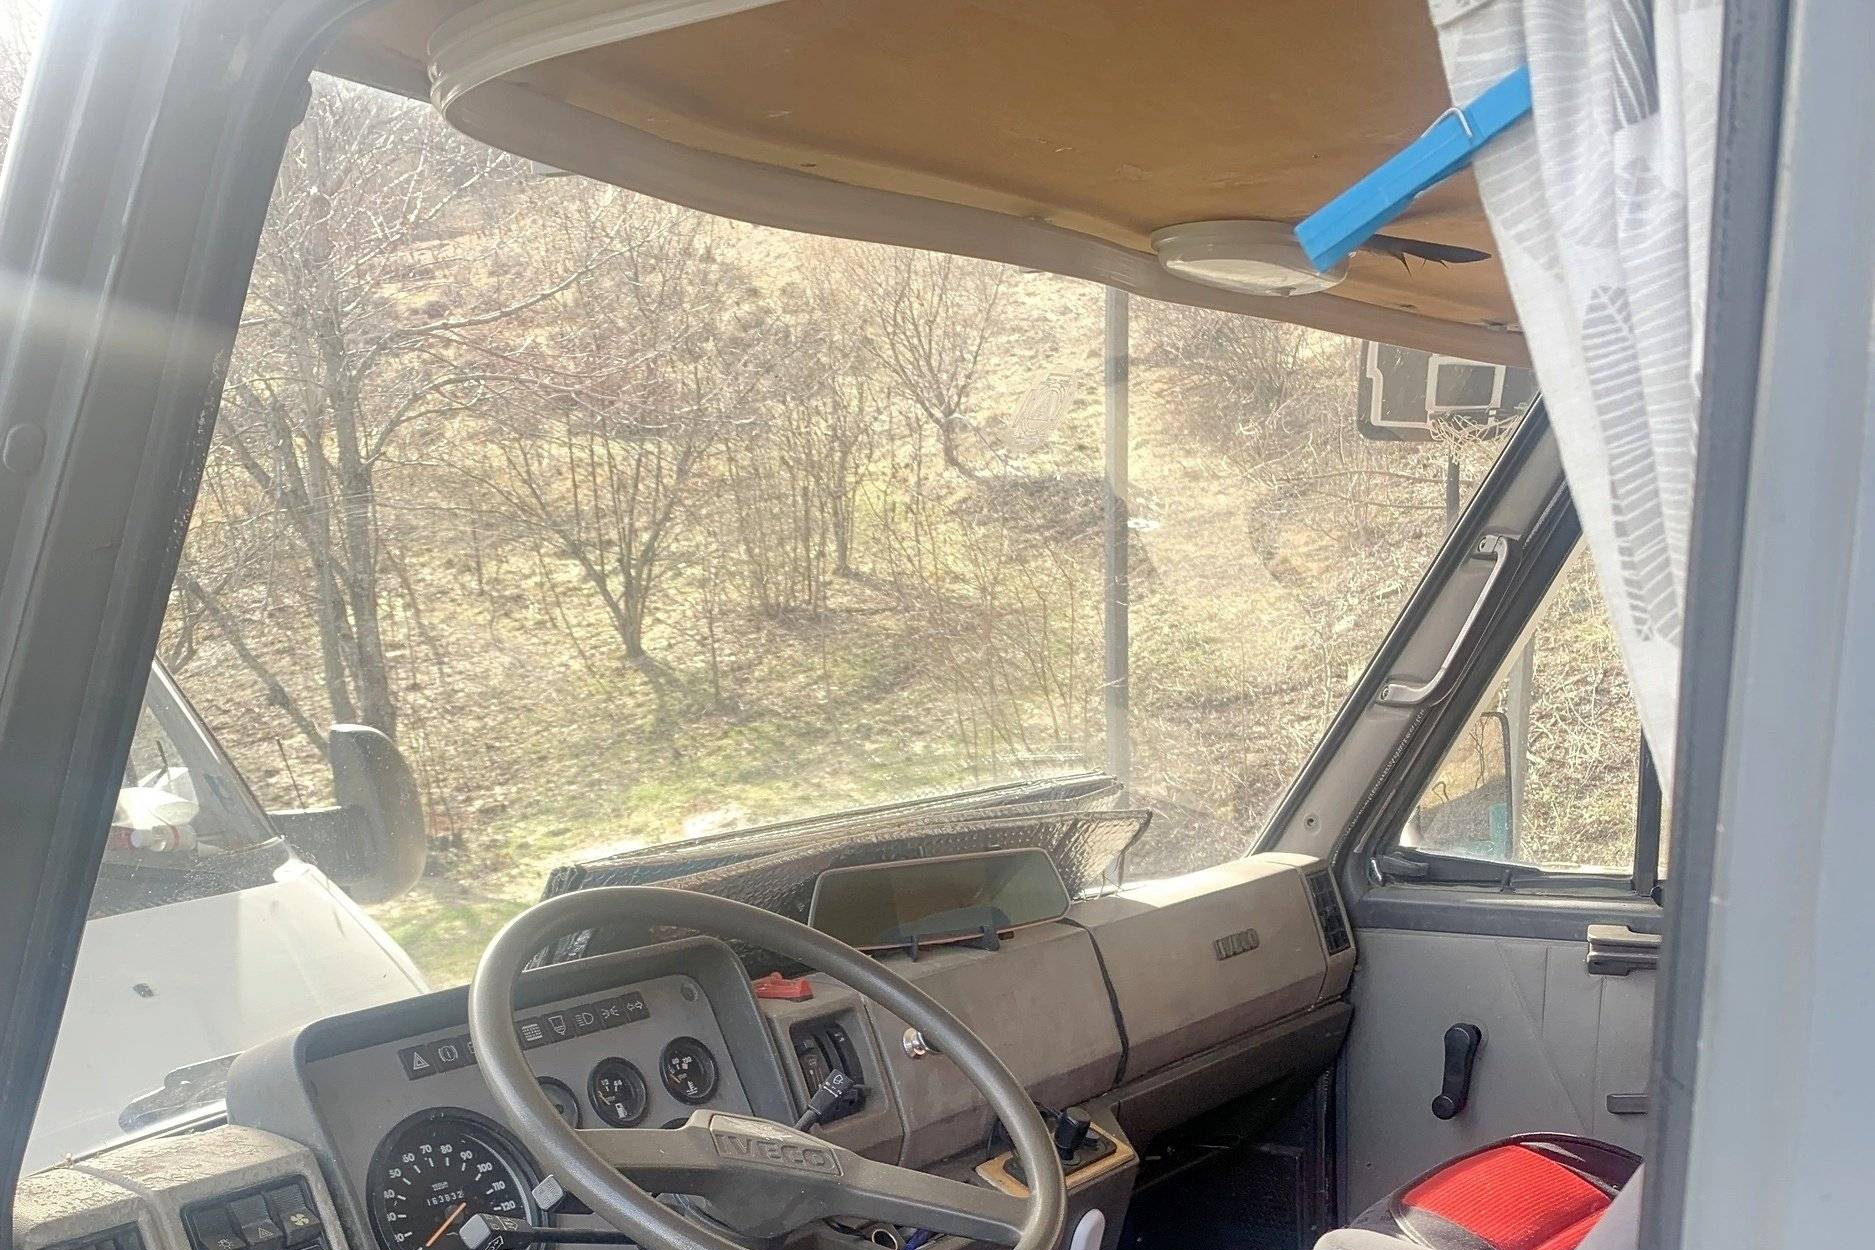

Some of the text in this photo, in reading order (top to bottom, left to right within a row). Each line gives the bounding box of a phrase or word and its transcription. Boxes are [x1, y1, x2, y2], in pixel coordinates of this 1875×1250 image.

[419, 1144, 432, 1154] 70
[440, 1144, 453, 1154] 80
[714, 1134, 829, 1168] IVECO
[460, 1150, 473, 1160] 90
[477, 1162, 492, 1173] 100
[389, 1168, 402, 1178] 50
[492, 1180, 505, 1190] 110
[501, 1200, 515, 1211] 120
